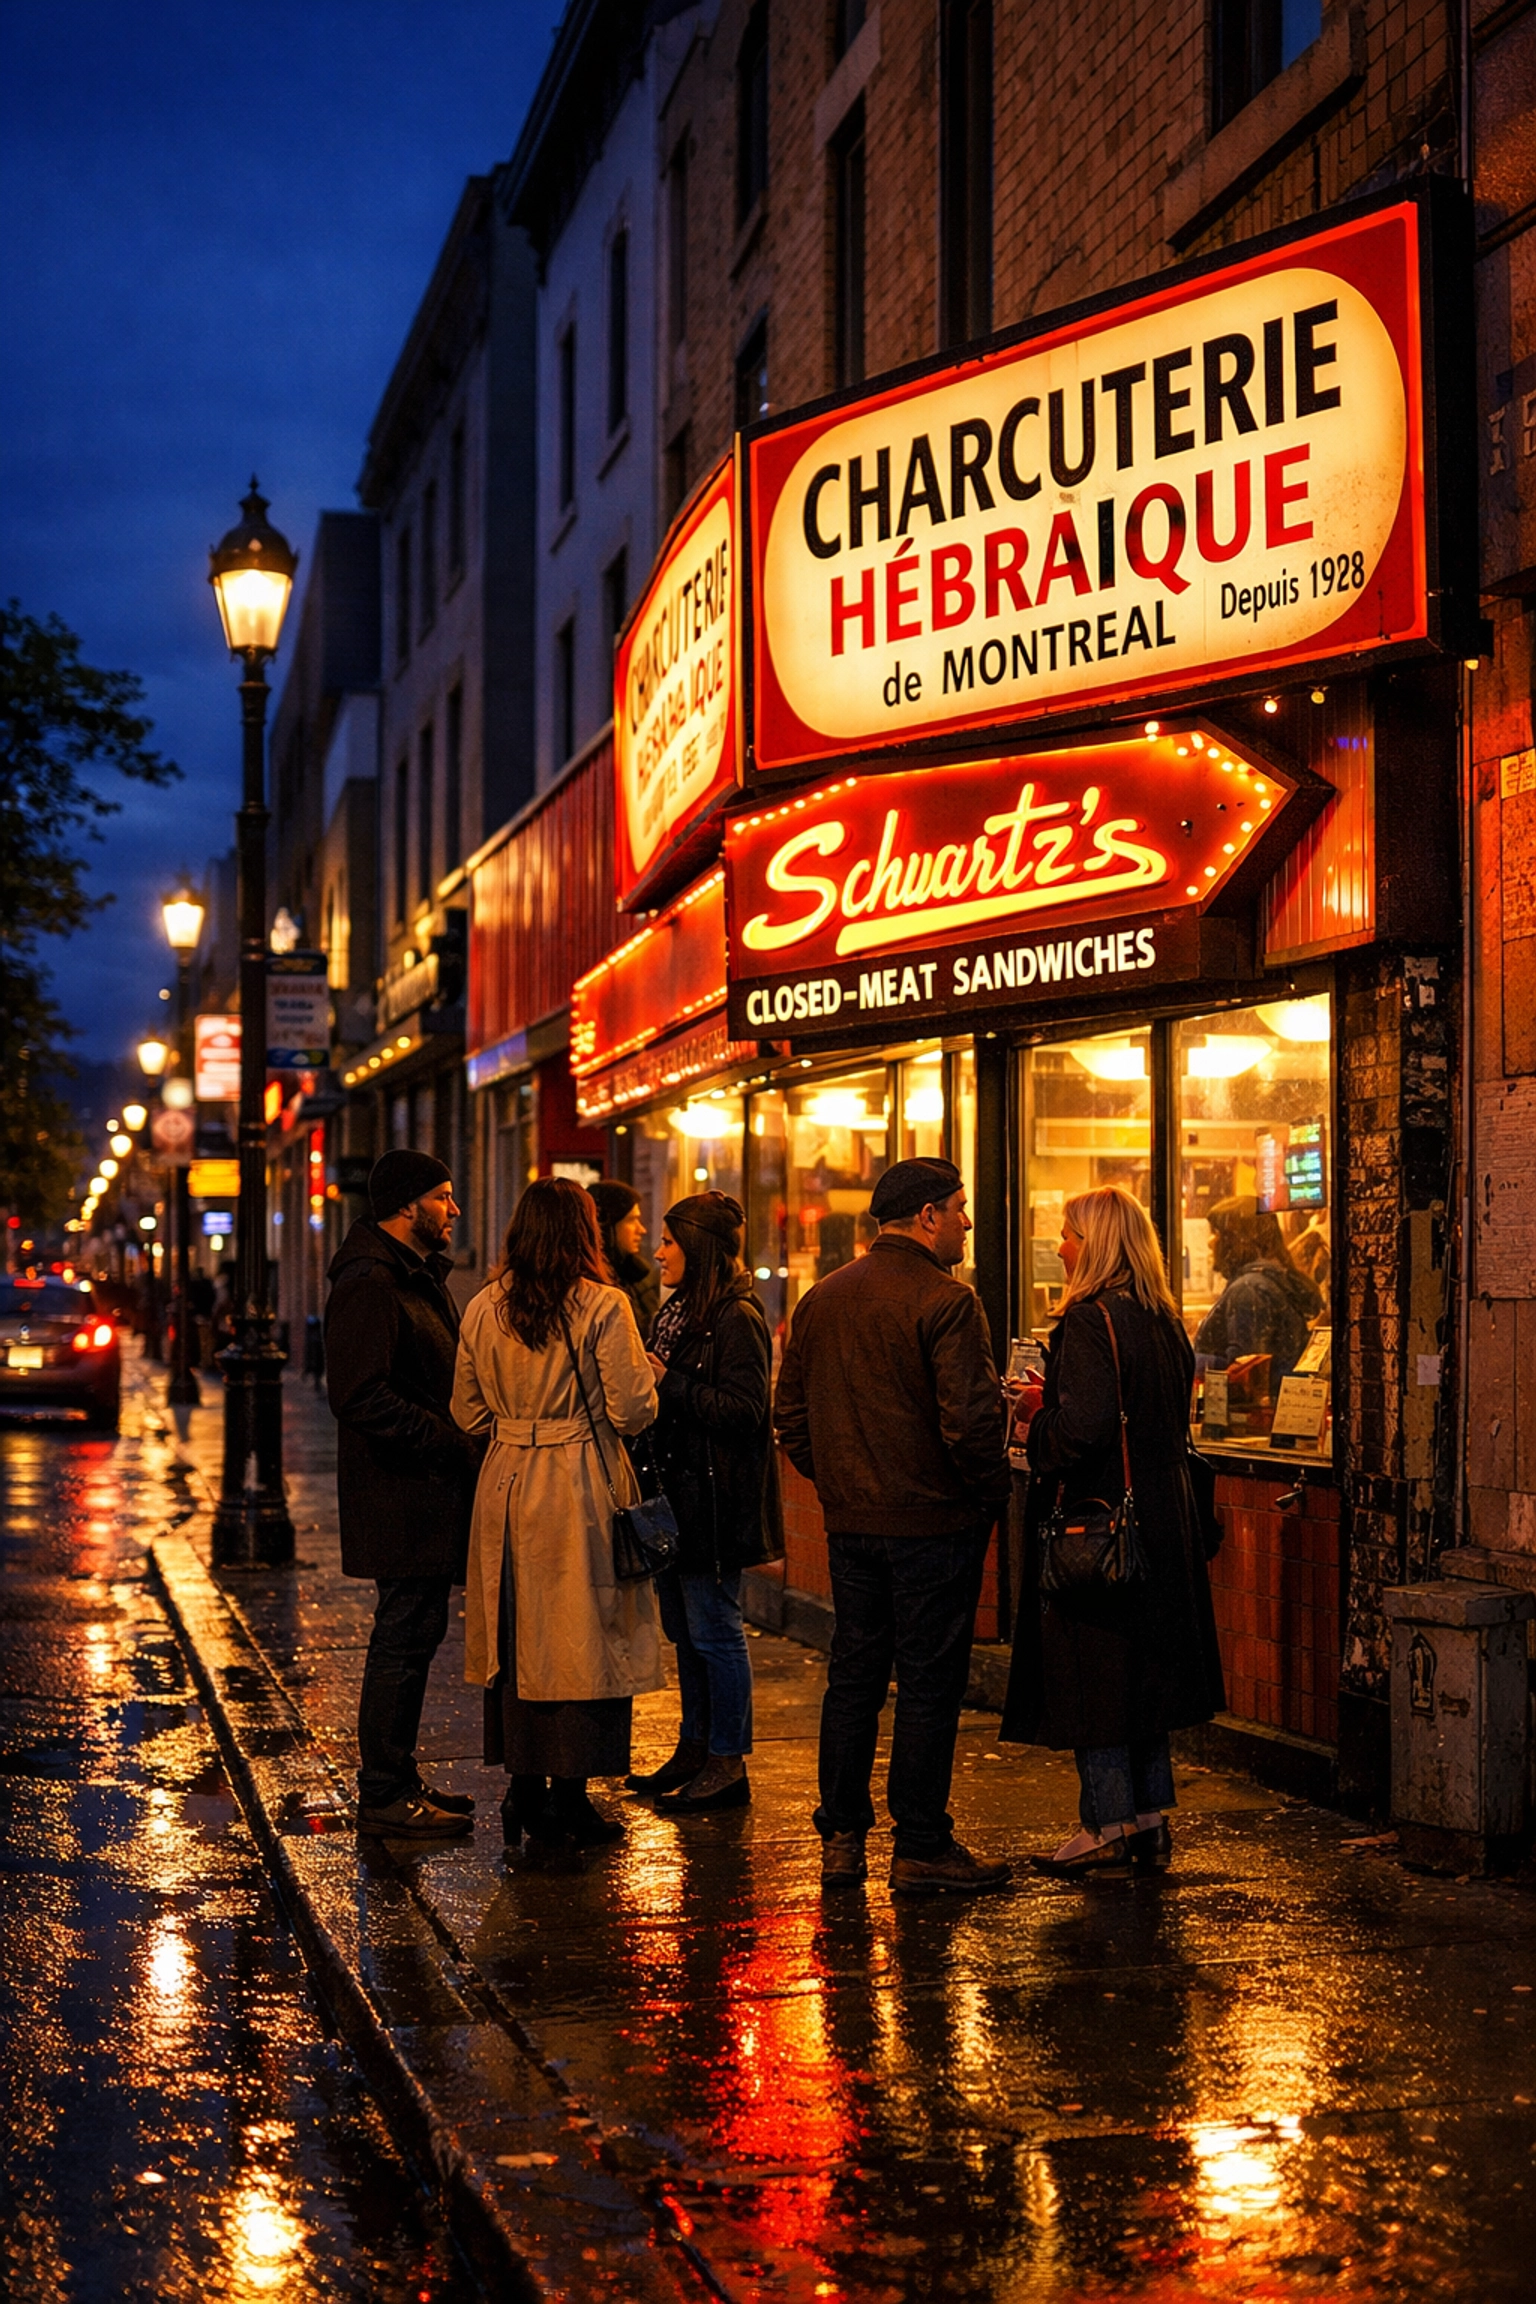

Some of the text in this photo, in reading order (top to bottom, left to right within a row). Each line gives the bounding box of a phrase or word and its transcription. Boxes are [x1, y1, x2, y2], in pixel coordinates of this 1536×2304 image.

[803, 299, 1341, 559] CHARCUTERIE
[830, 443, 1314, 656] HÉBRAIQUE
[1220, 550, 1365, 623] Depuis 1928
[631, 538, 728, 735] CCUTERIE
[883, 600, 1176, 707] de MONTREAL
[746, 928, 1156, 1026] CLOSED-MEAT SANDWICHES
